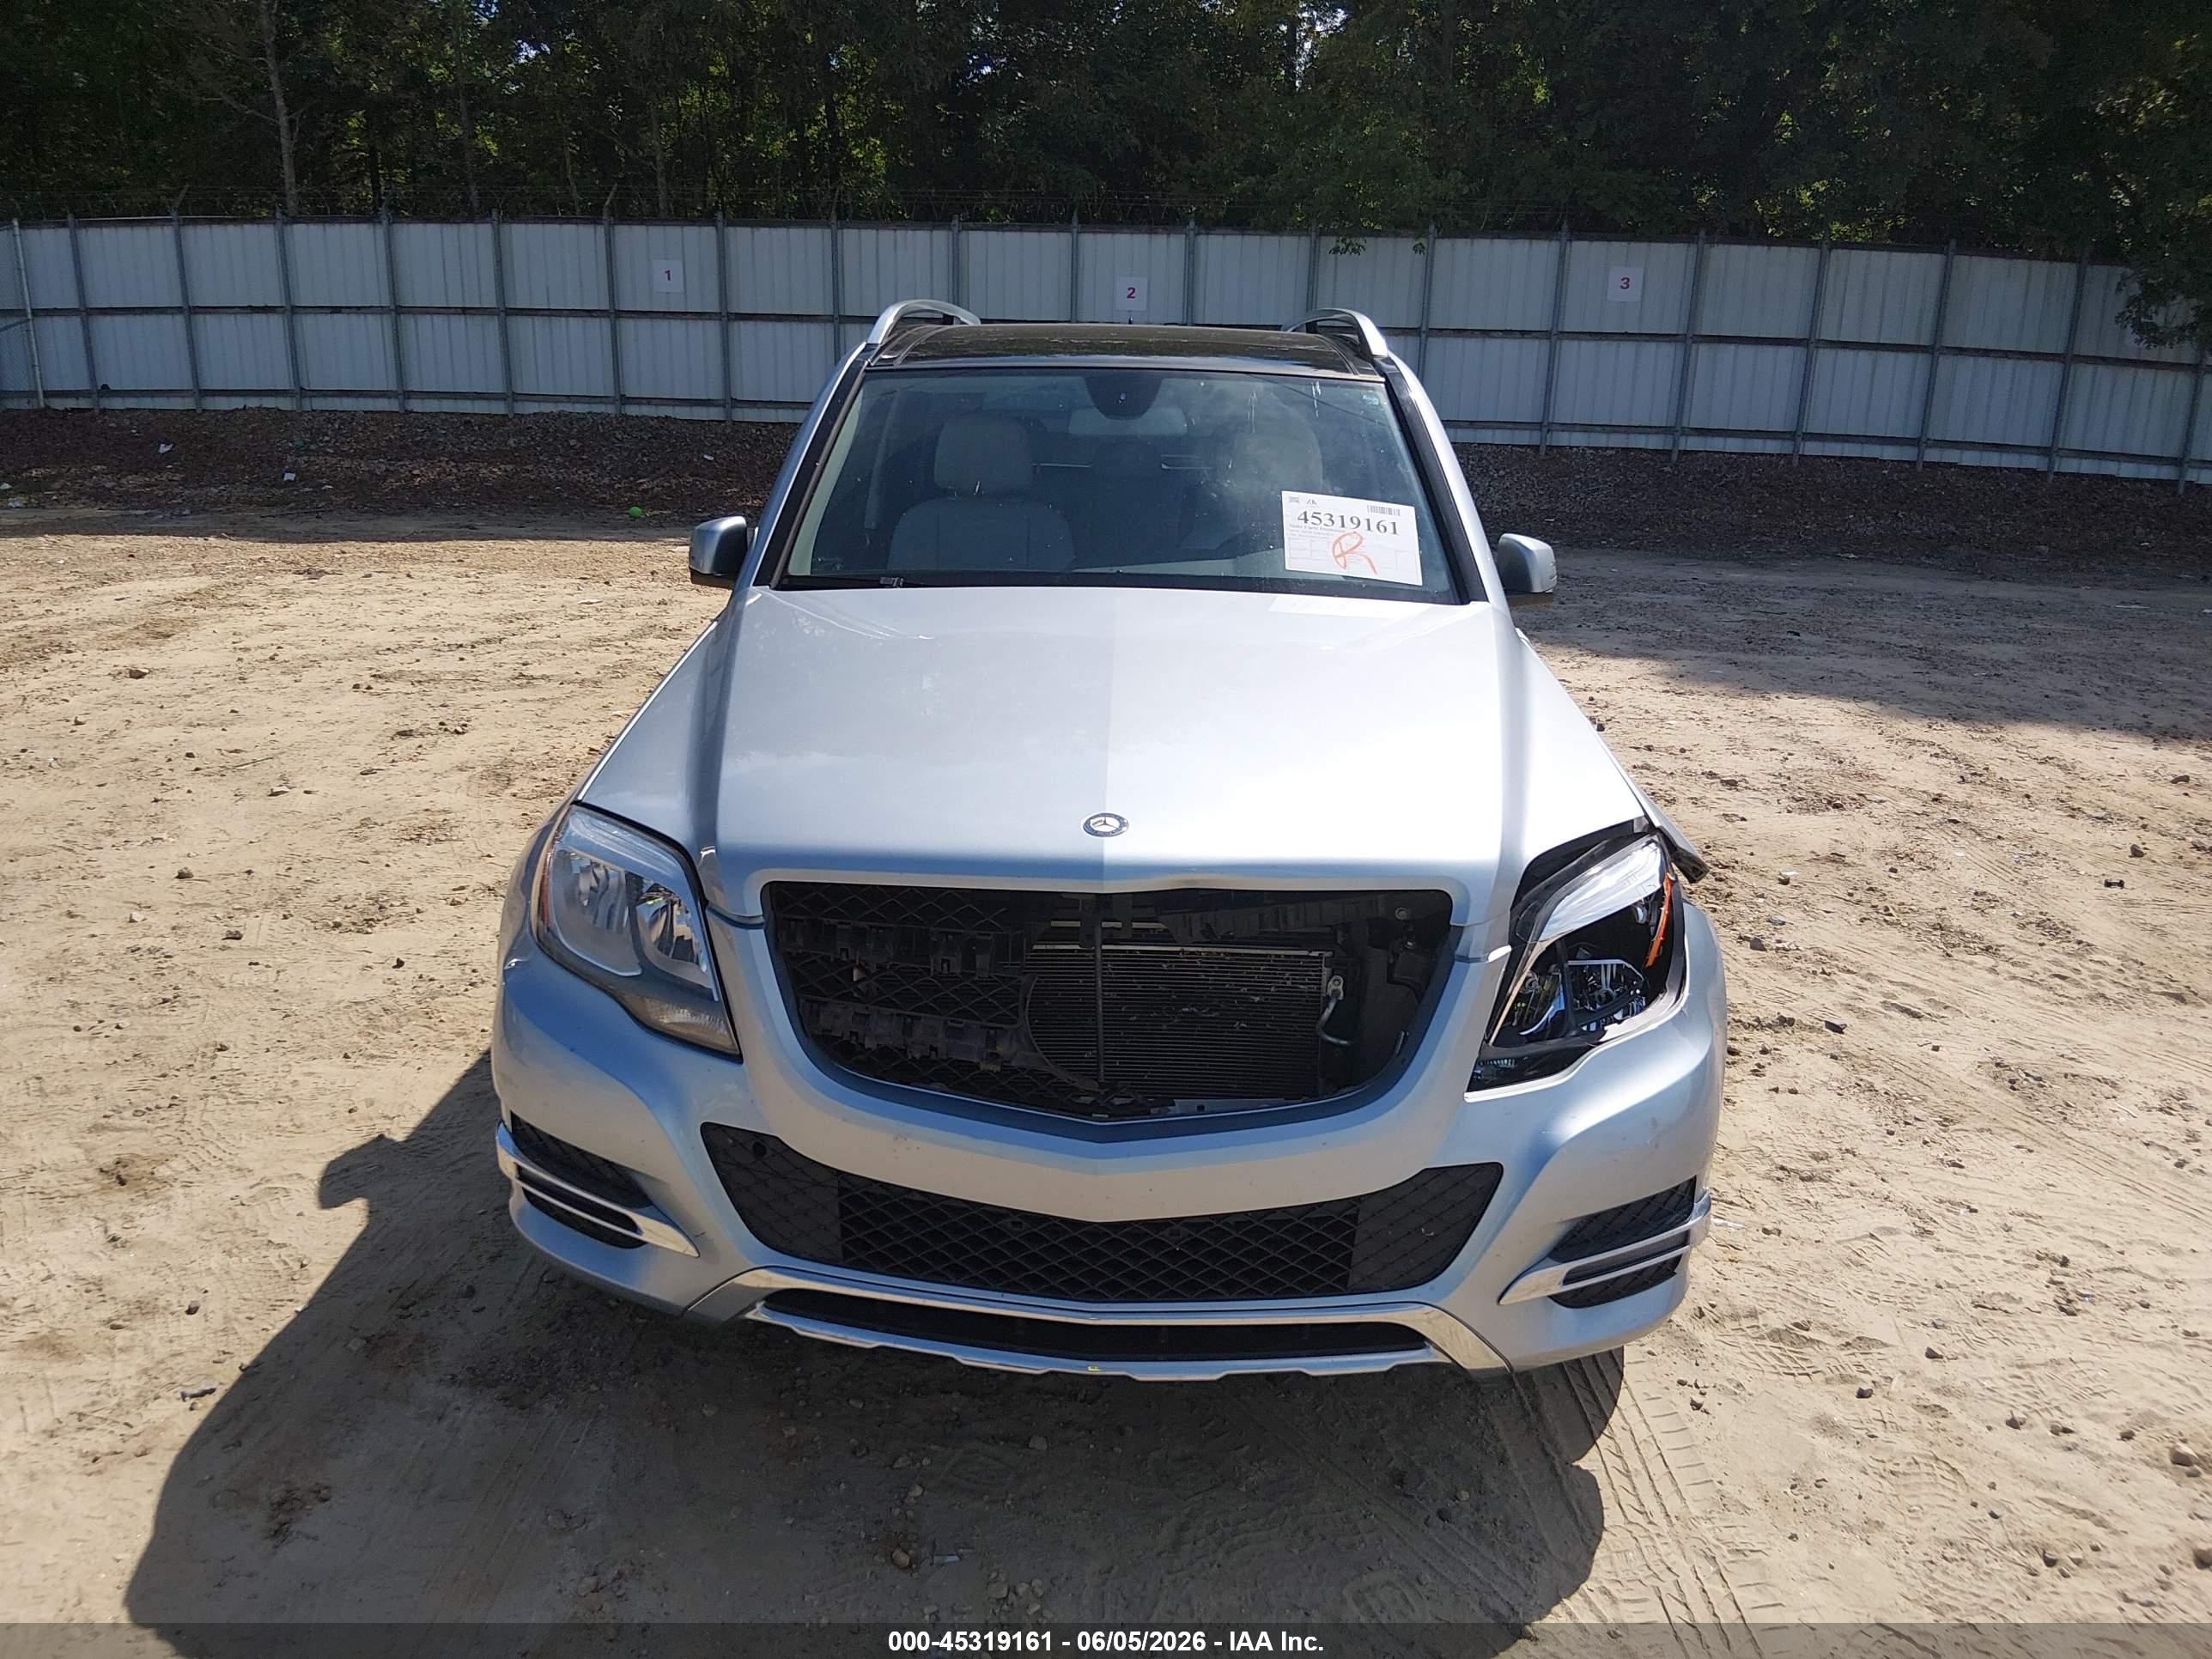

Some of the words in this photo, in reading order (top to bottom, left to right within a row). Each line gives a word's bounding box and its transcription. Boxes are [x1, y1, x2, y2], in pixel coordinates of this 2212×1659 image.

[664, 270, 671, 282] 1
[1620, 276, 1631, 290] 3
[1127, 287, 1136, 299] 2
[1297, 510, 1401, 535] 45319161
